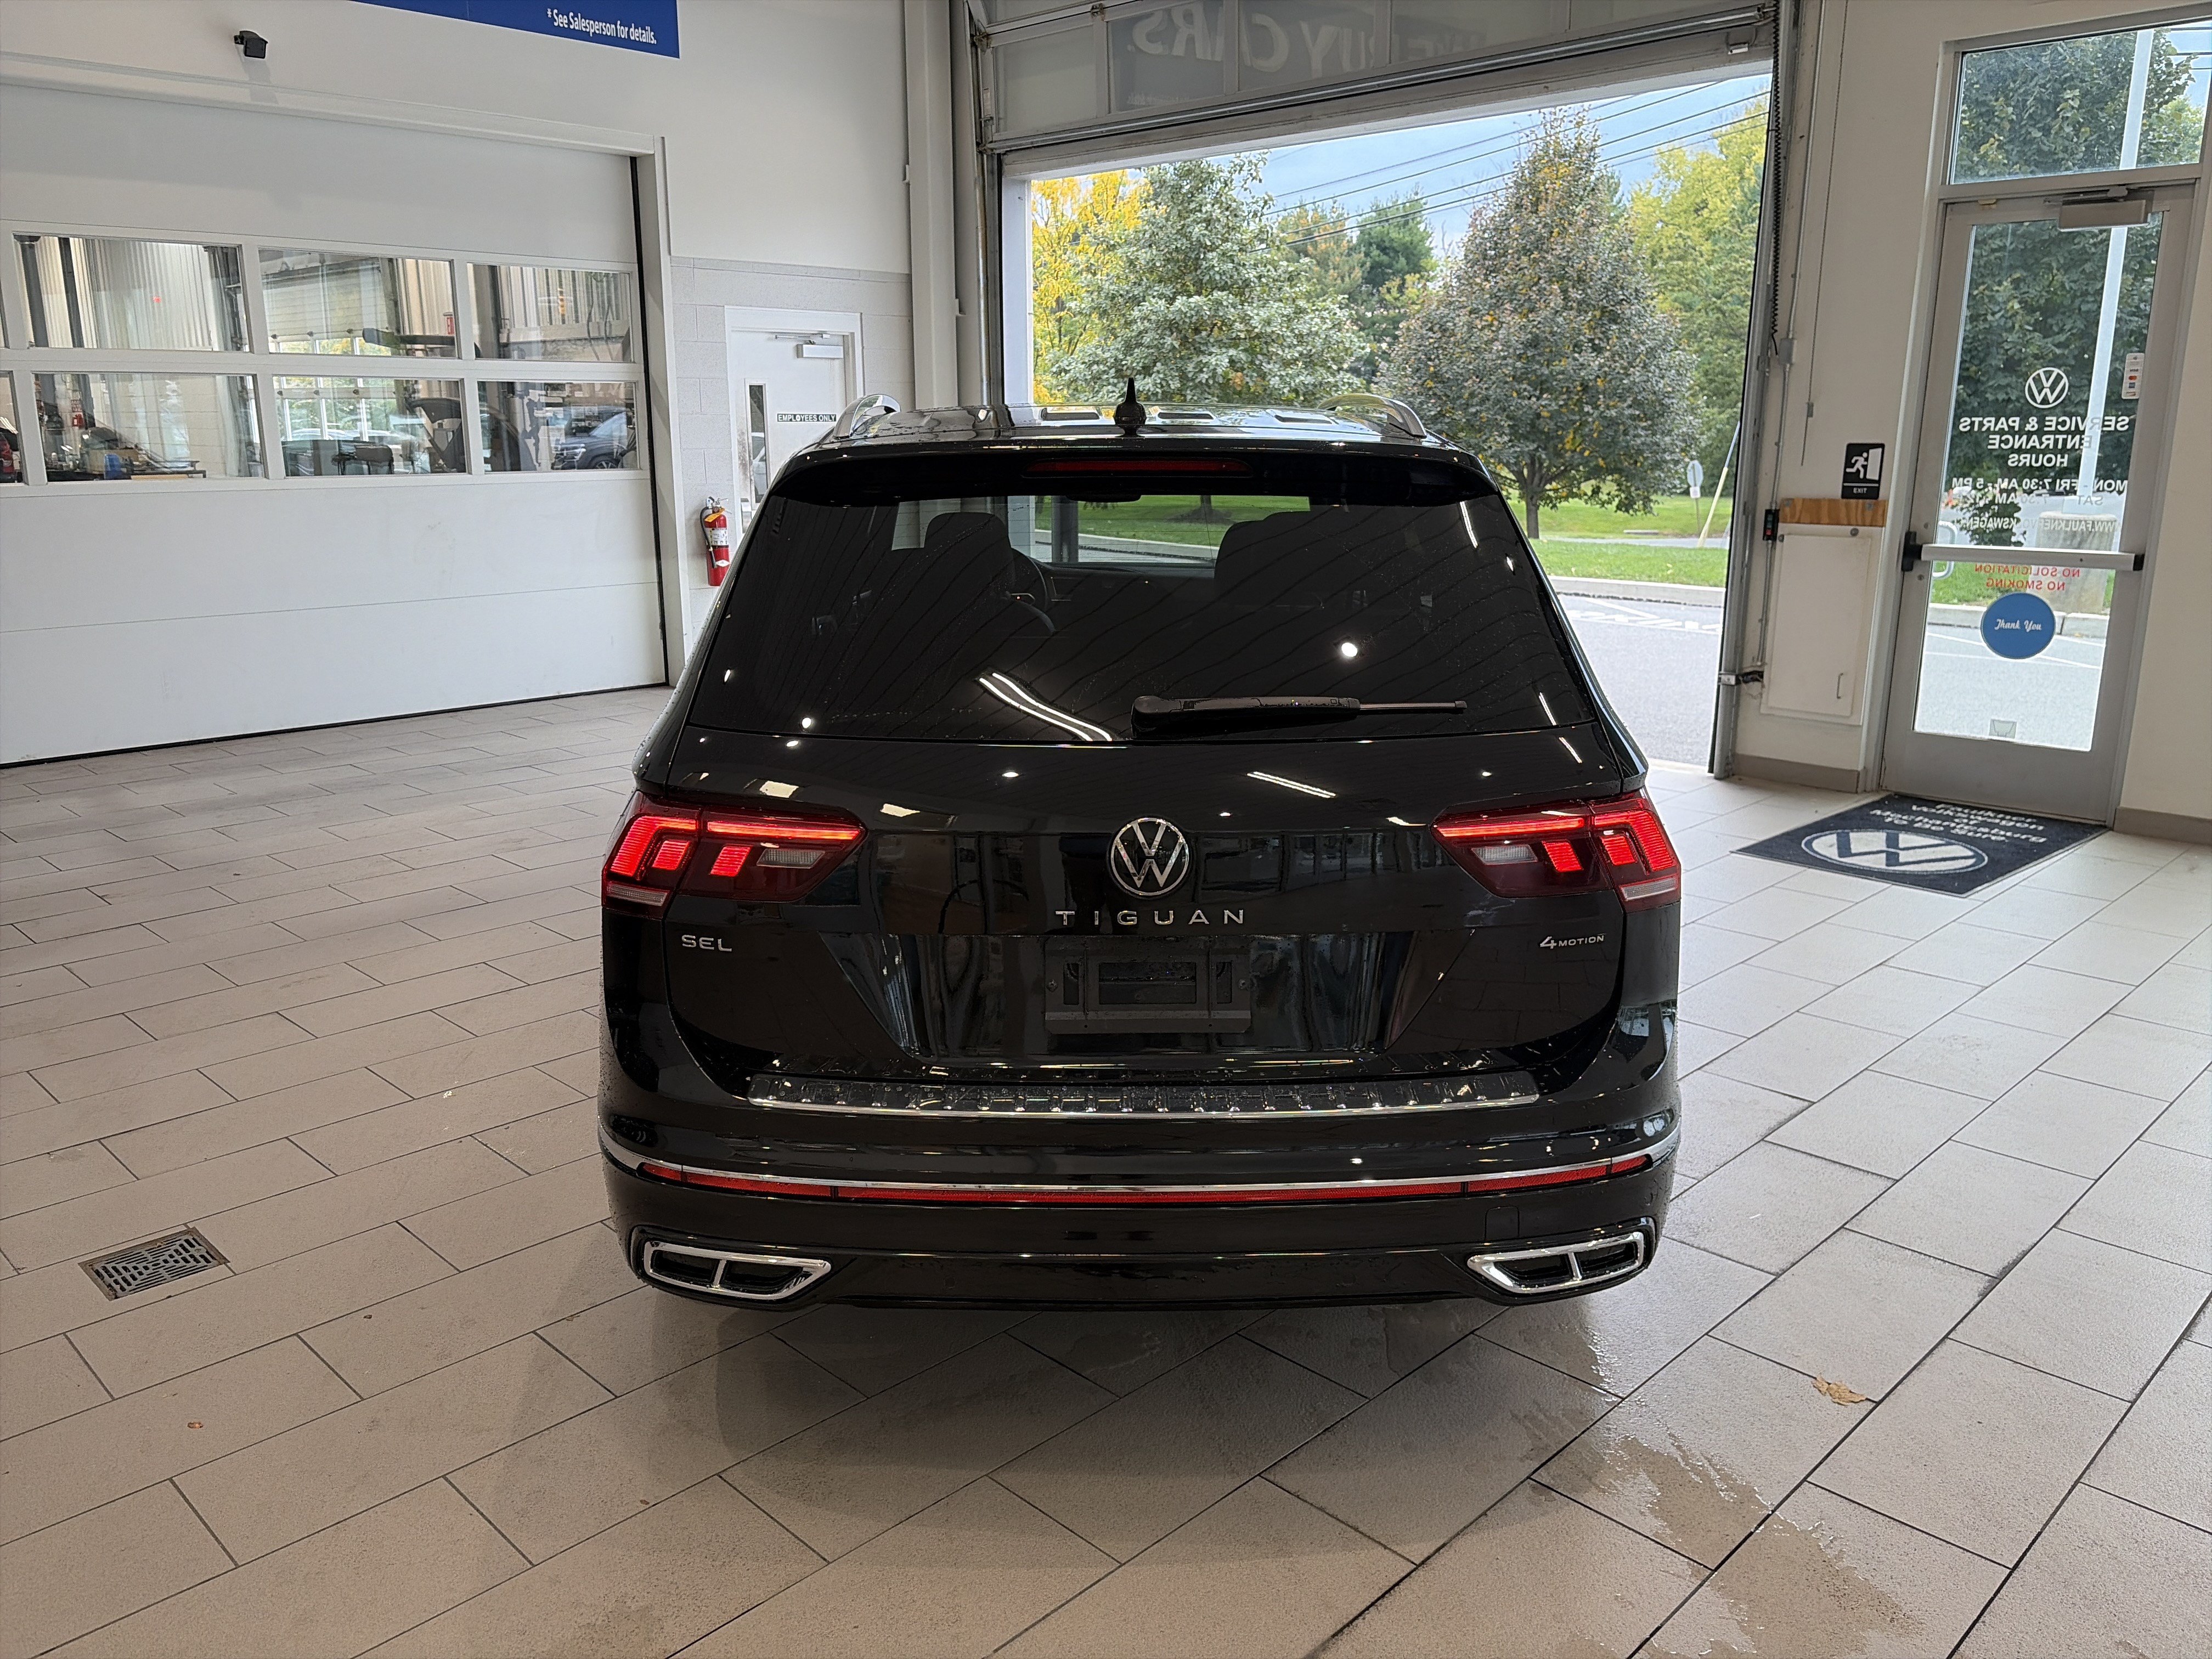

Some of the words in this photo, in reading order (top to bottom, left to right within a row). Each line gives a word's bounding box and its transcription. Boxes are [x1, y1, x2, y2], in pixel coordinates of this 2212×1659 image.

[569, 12, 616, 37] Salesperson
[617, 20, 628, 39] for
[629, 24, 657, 44] details.
[1994, 618, 2021, 630] Thank
[2024, 620, 2042, 633] You
[1056, 910, 1244, 925] TIGUAN
[681, 934, 732, 952] SEL
[1539, 935, 1605, 950] 4MOTION
